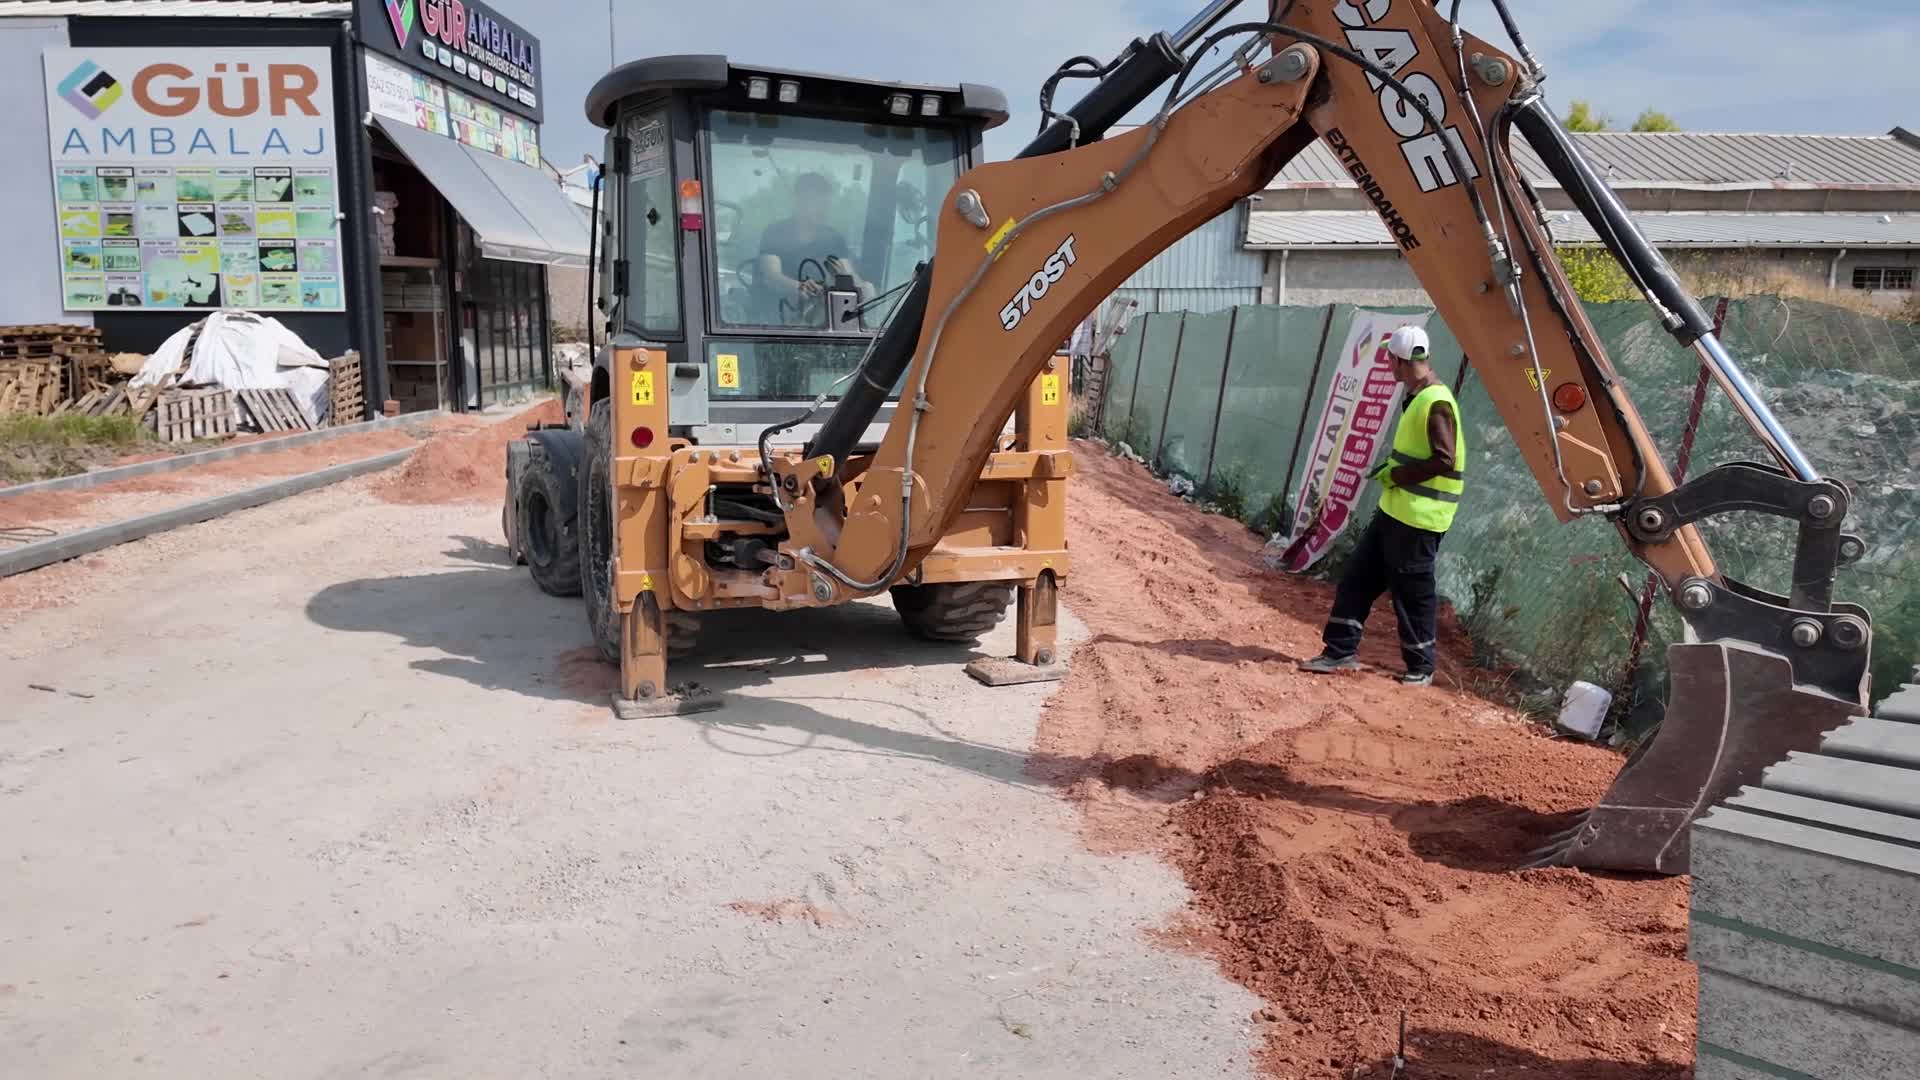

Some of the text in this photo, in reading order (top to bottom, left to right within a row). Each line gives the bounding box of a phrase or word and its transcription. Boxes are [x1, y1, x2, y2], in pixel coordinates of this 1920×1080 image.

[420, 0, 533, 73] GÜR AMBALAJ
[132, 62, 321, 117] GÜR
[61, 126, 325, 155] AMBALAJ
[1325, 127, 1421, 251] EXTENDAHOE
[998, 231, 1077, 331] 570ST
